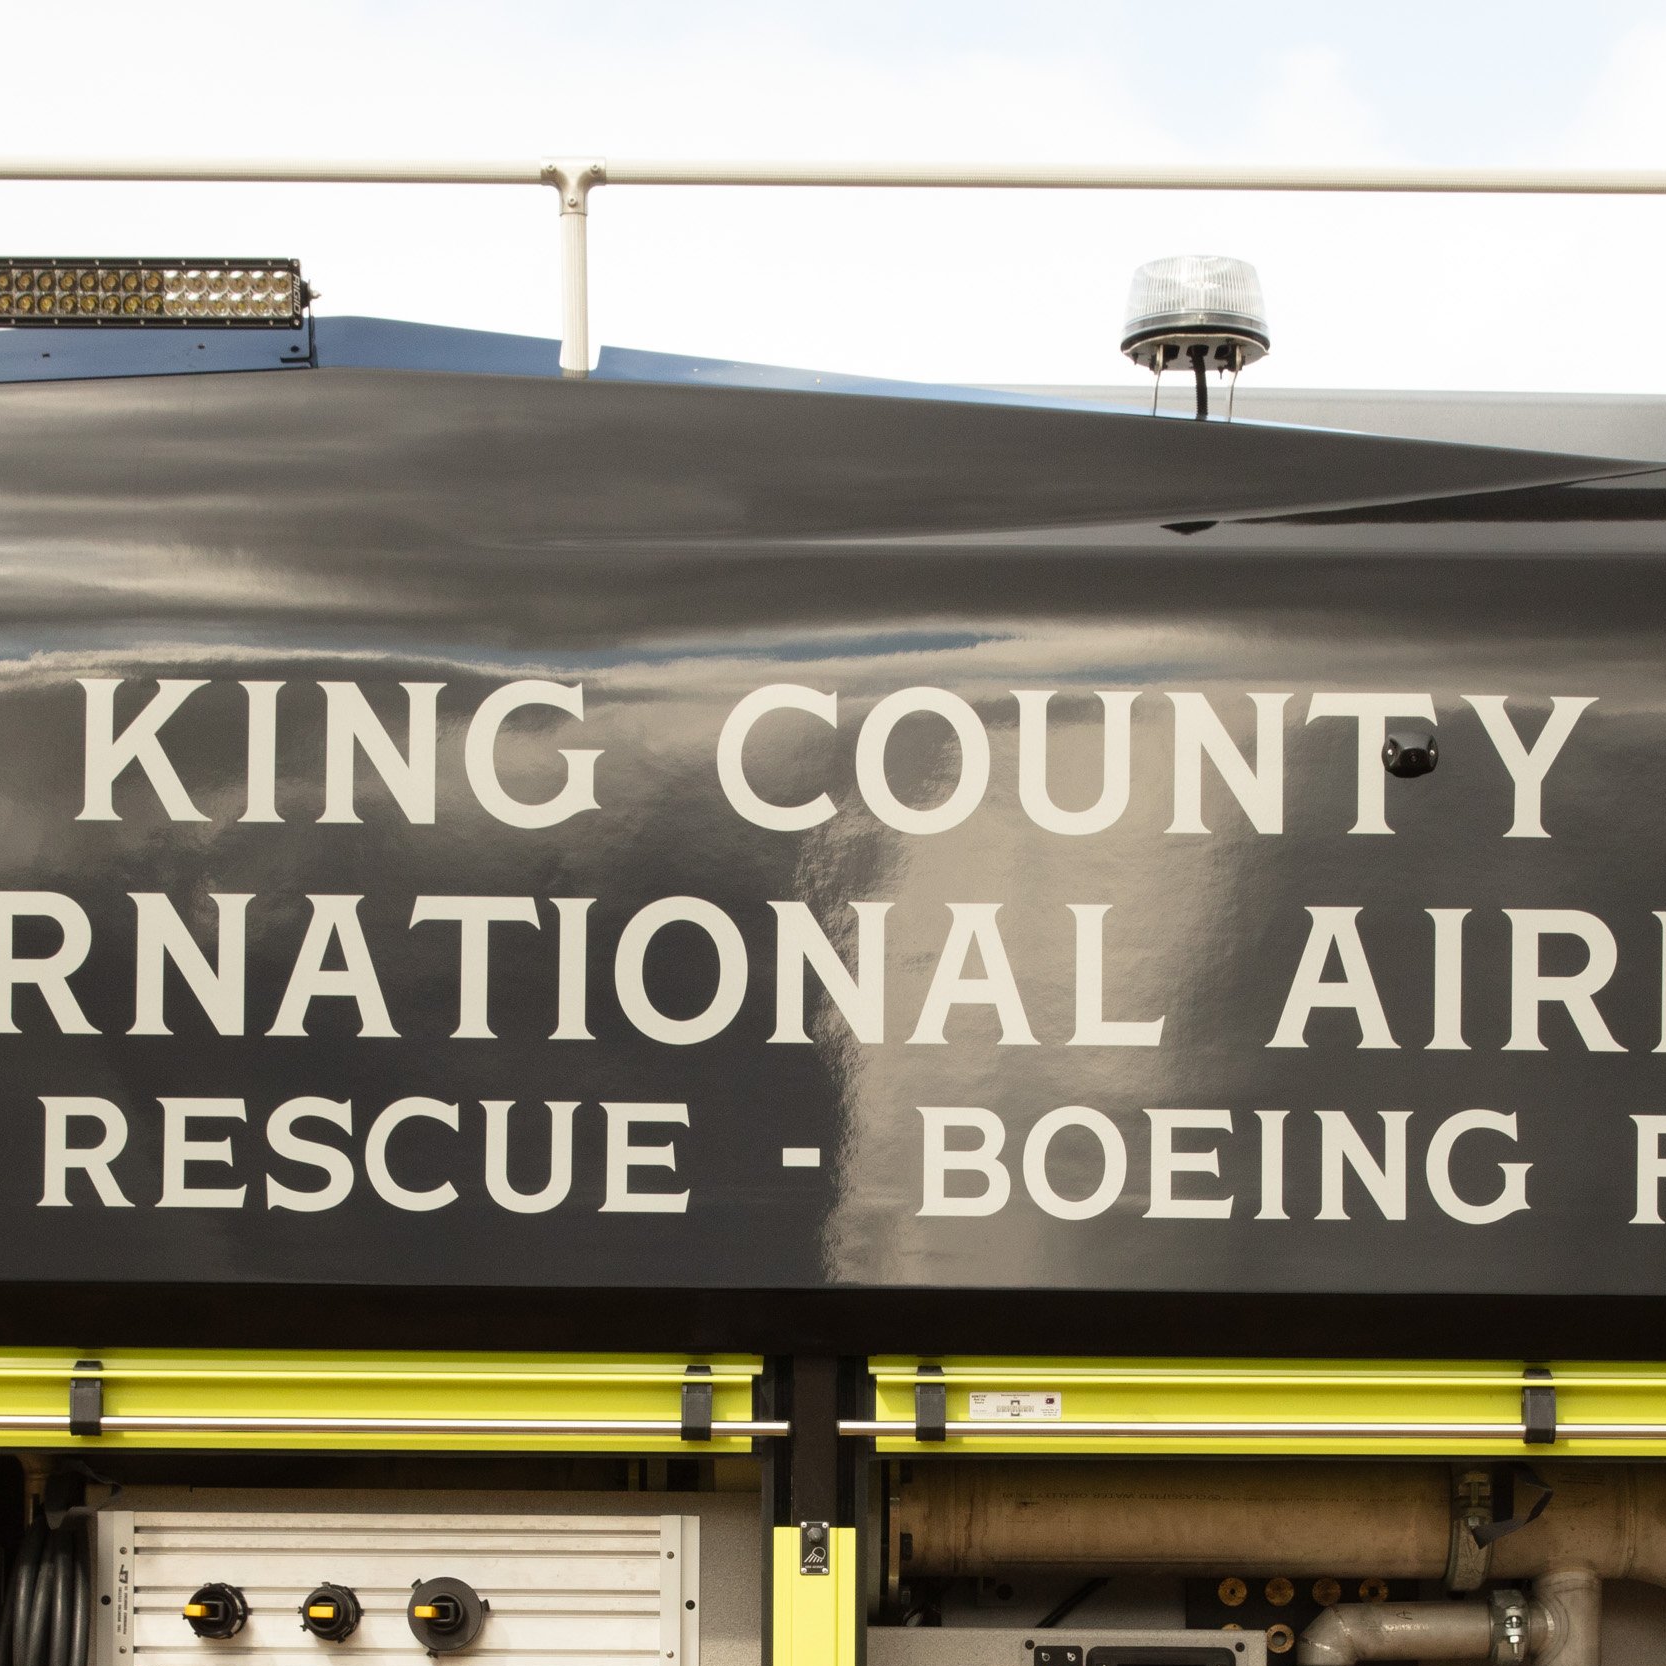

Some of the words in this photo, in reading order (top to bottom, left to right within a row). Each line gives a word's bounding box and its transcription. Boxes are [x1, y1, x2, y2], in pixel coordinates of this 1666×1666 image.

[292, 273, 301, 315] RIGID
[74, 679, 605, 829] KING
[716, 684, 1600, 838] COUNTY
[37, 1095, 691, 1214] RESCUE
[782, 1148, 821, 1167] -
[915, 1105, 1534, 1225] BOEING
